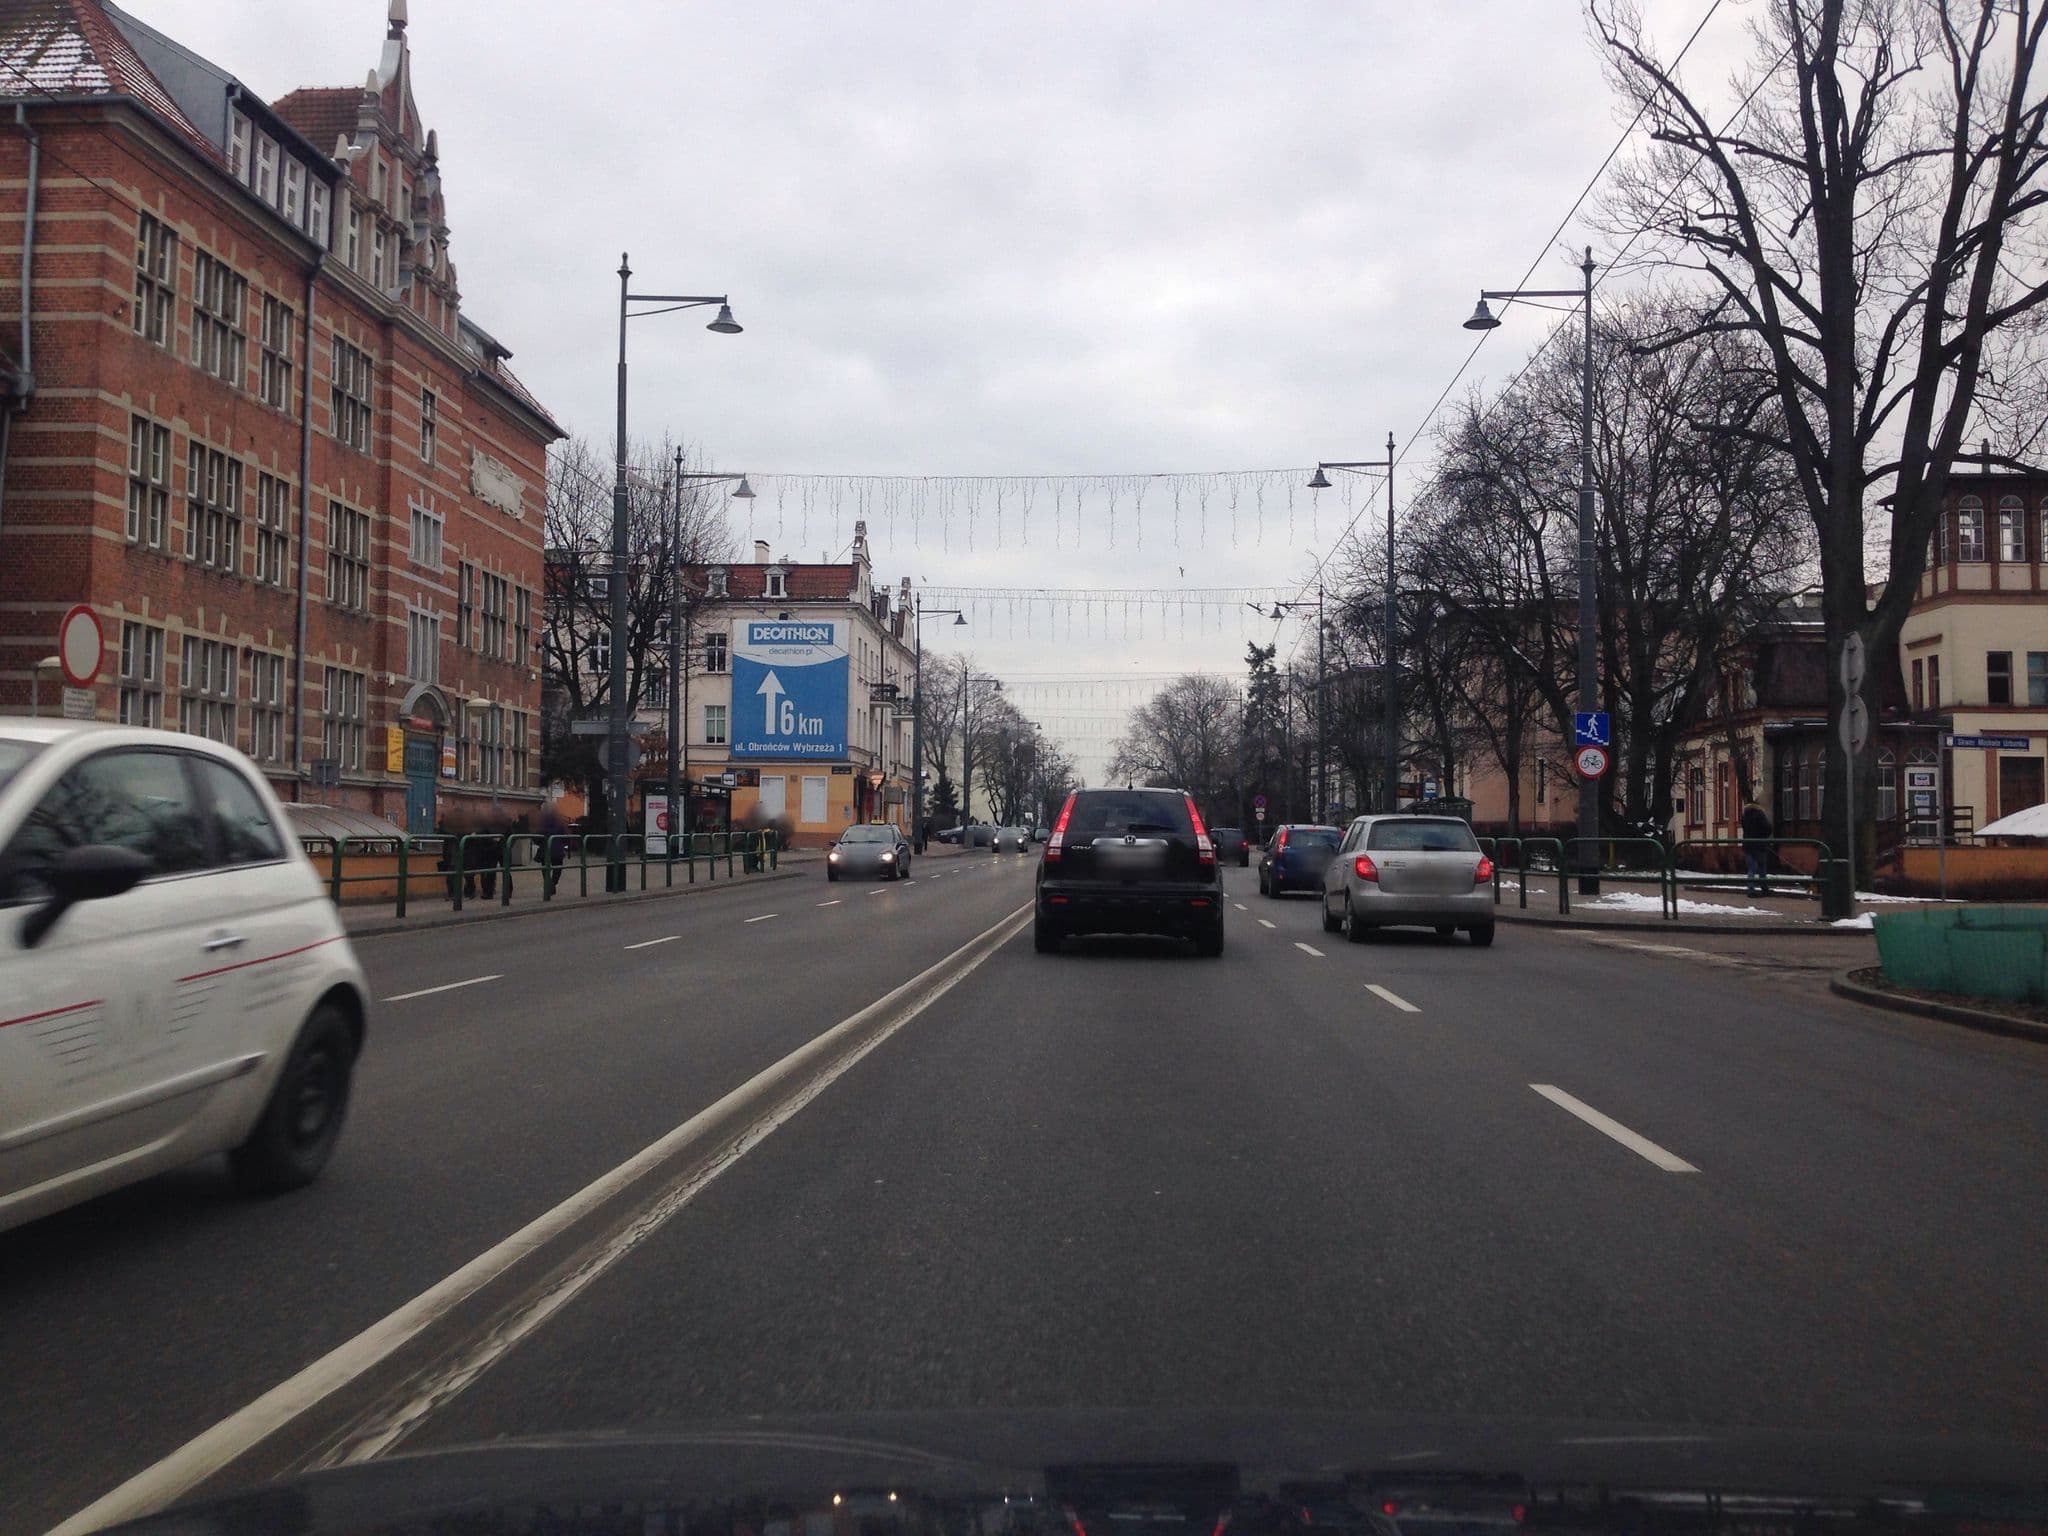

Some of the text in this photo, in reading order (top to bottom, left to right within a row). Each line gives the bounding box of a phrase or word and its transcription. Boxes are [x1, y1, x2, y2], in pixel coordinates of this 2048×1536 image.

[753, 627, 829, 641] DECATHLON
[780, 699, 823, 736] 6 km
[735, 742, 843, 754] ul. Obrońców Wybrzeża 1
